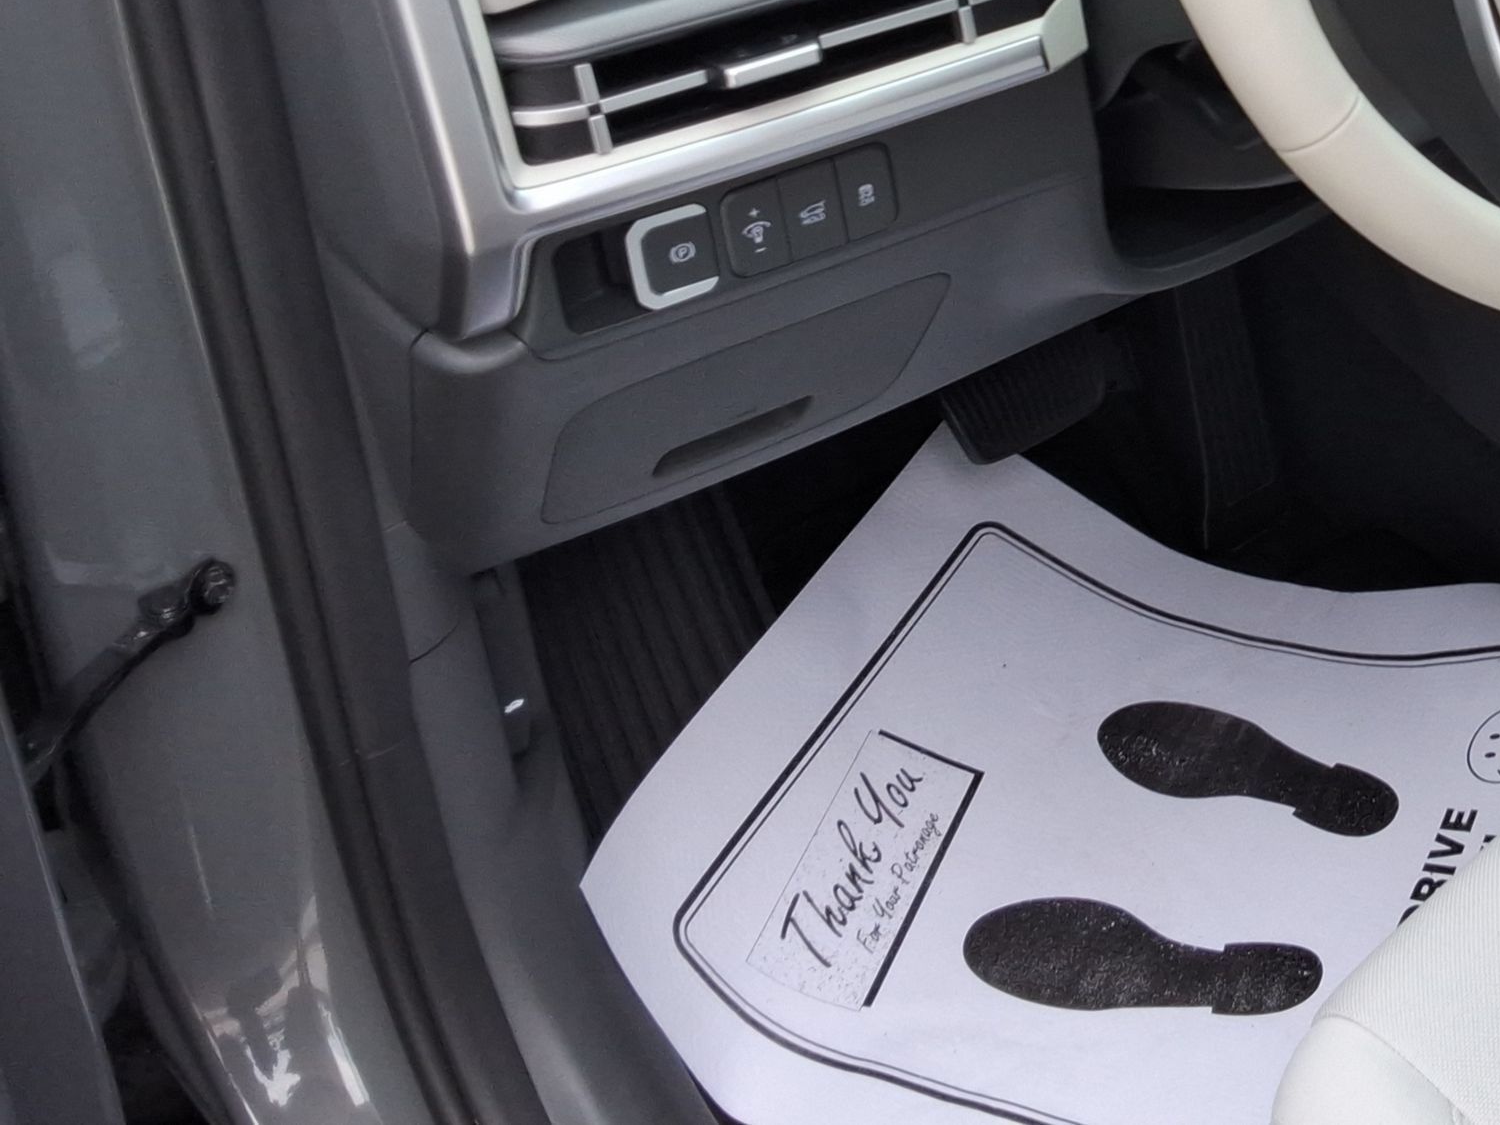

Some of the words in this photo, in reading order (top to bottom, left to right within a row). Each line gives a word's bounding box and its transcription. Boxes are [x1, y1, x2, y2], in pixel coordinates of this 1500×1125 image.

[780, 819, 882, 969] Thank
[853, 767, 923, 829] You
[856, 922, 885, 955] For
[874, 885, 901, 921] Your
[890, 812, 942, 886] Patronage
